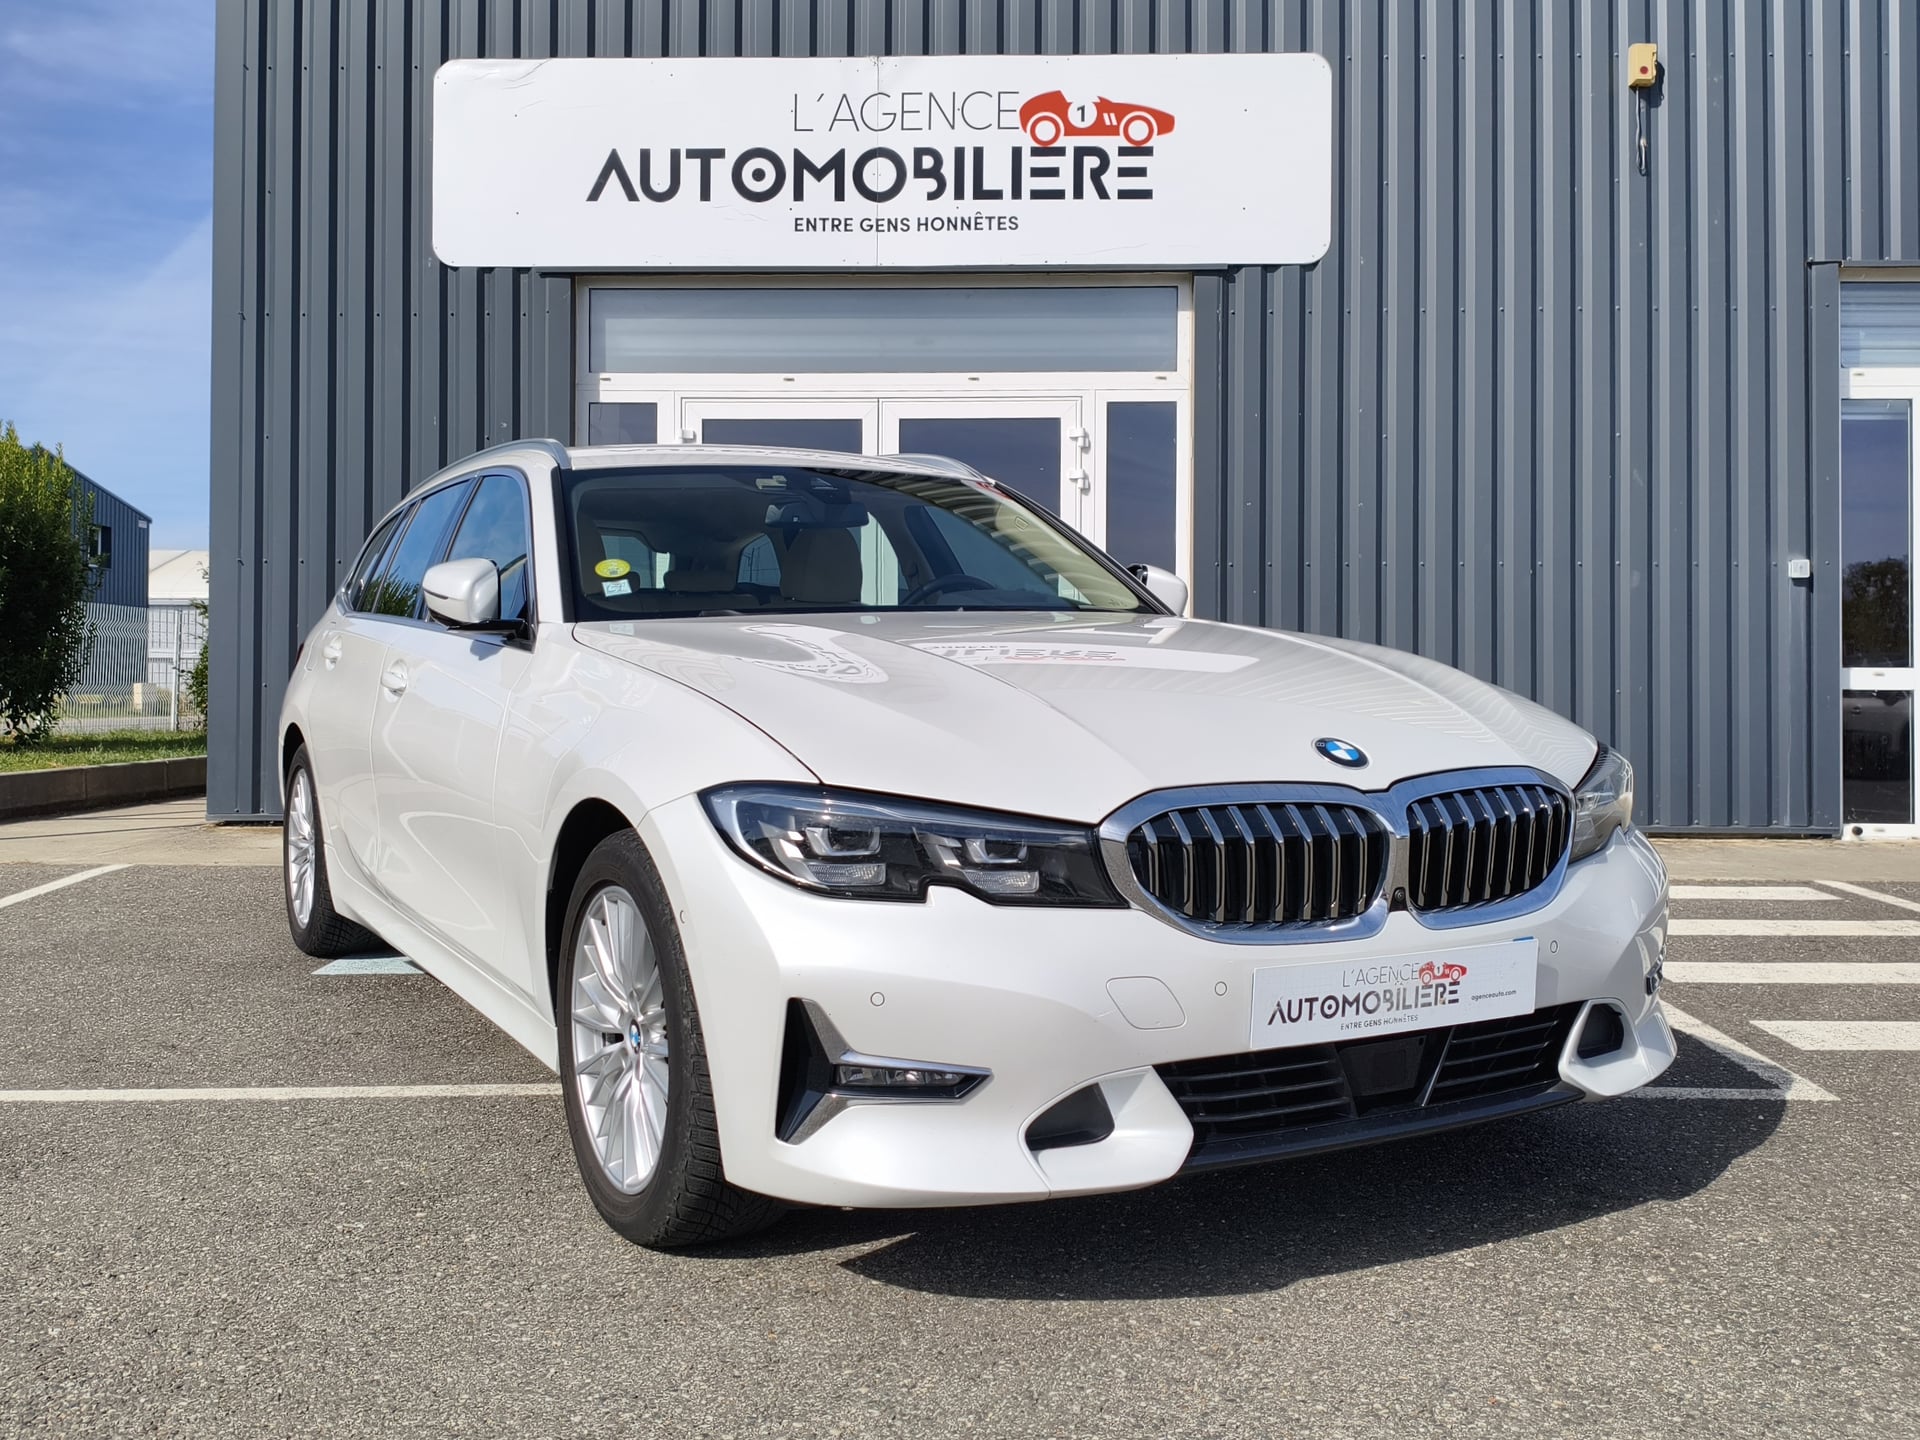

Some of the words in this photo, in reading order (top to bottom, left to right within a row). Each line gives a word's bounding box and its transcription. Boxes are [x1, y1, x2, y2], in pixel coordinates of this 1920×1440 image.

[793, 91, 1020, 132] L'AGENCE
[1076, 104, 1086, 123] 1
[794, 217, 854, 232] ENTRE
[859, 217, 911, 232] GENS
[917, 211, 1019, 231] HONNÊTES
[1342, 962, 1420, 988] L'AGENCE
[1470, 989, 1517, 1002] agenceauto.com
[1340, 1020, 1362, 1031] ENTRE
[1363, 1018, 1382, 1029] GENS
